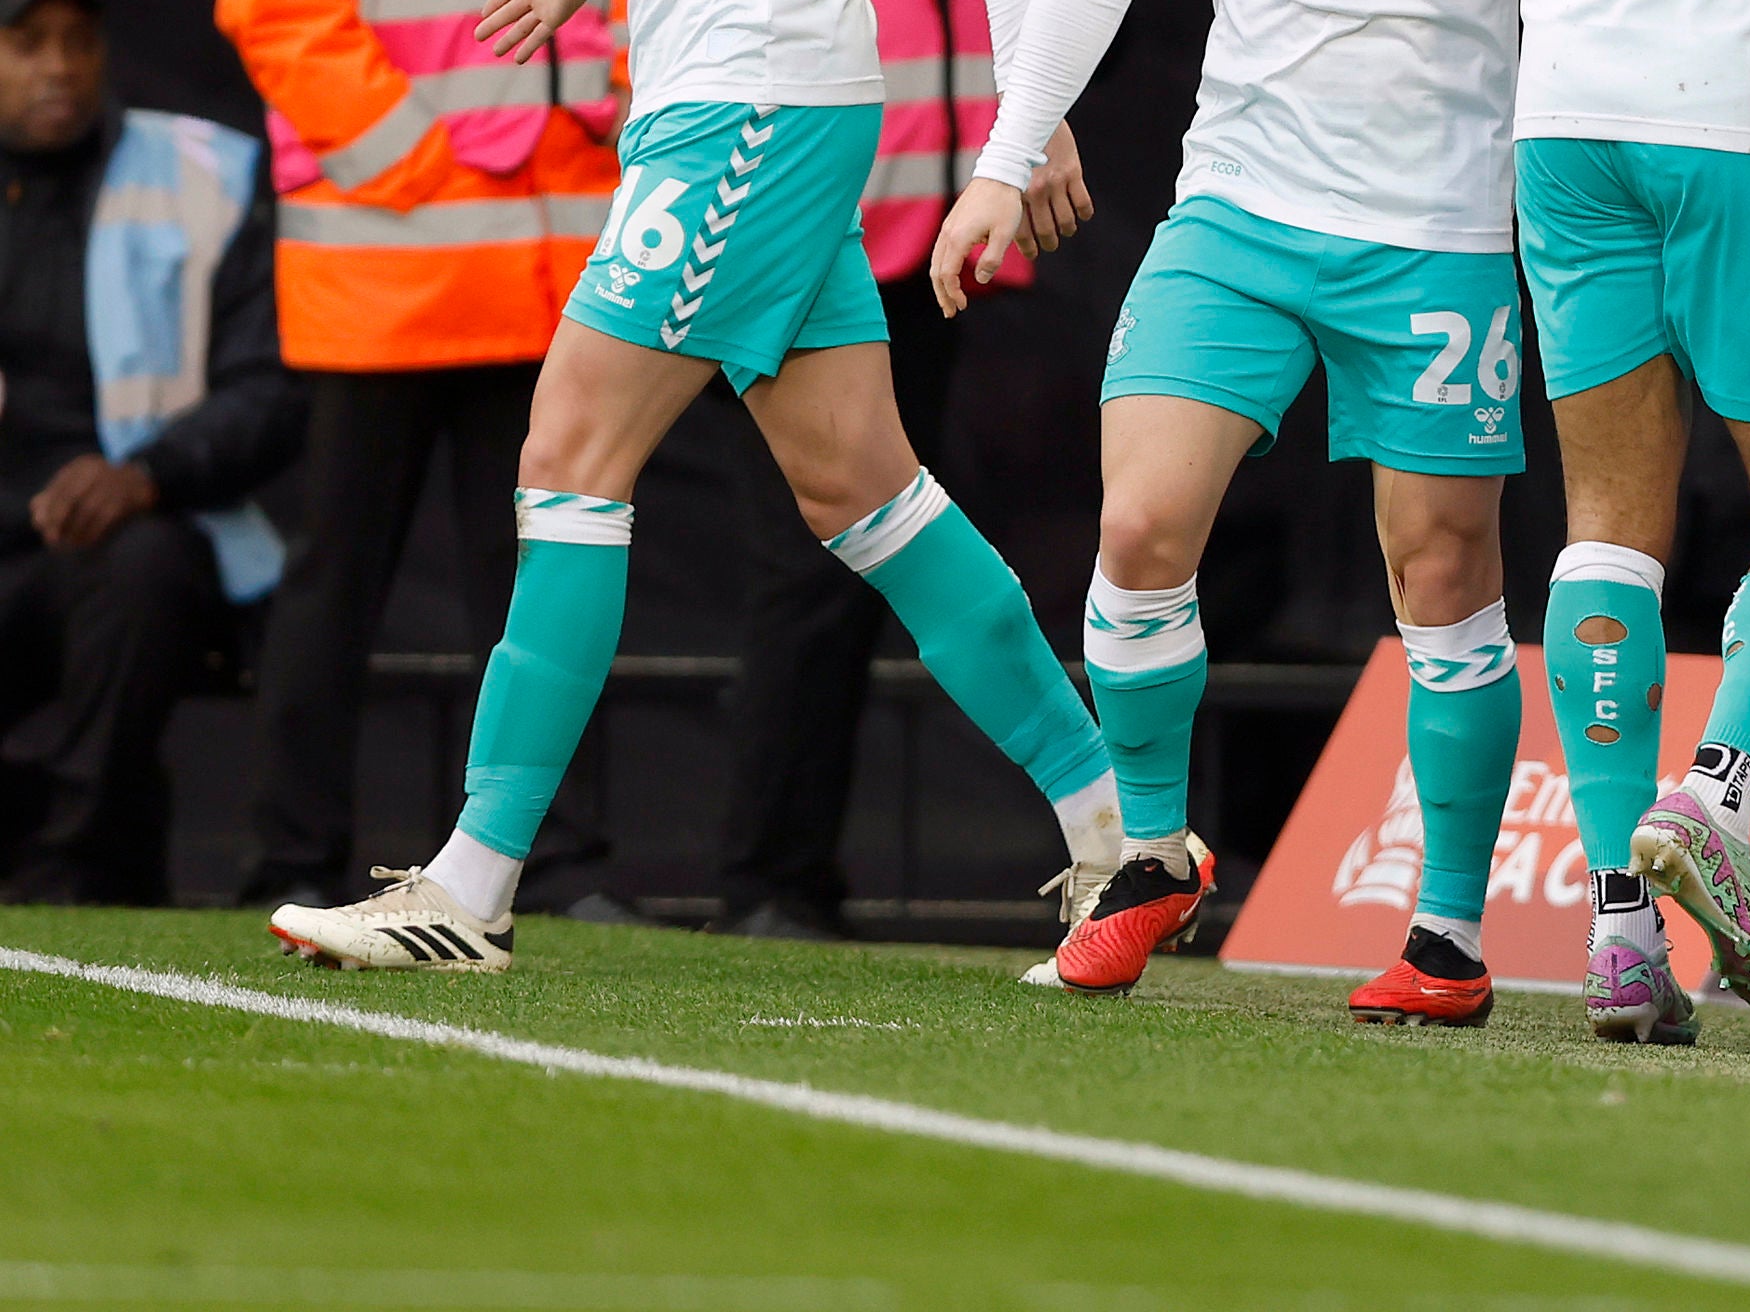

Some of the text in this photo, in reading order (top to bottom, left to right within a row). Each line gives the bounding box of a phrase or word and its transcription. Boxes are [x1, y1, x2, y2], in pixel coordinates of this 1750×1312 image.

[598, 164, 691, 270] 16
[594, 283, 635, 309] hummel
[1410, 305, 1518, 403] 26
